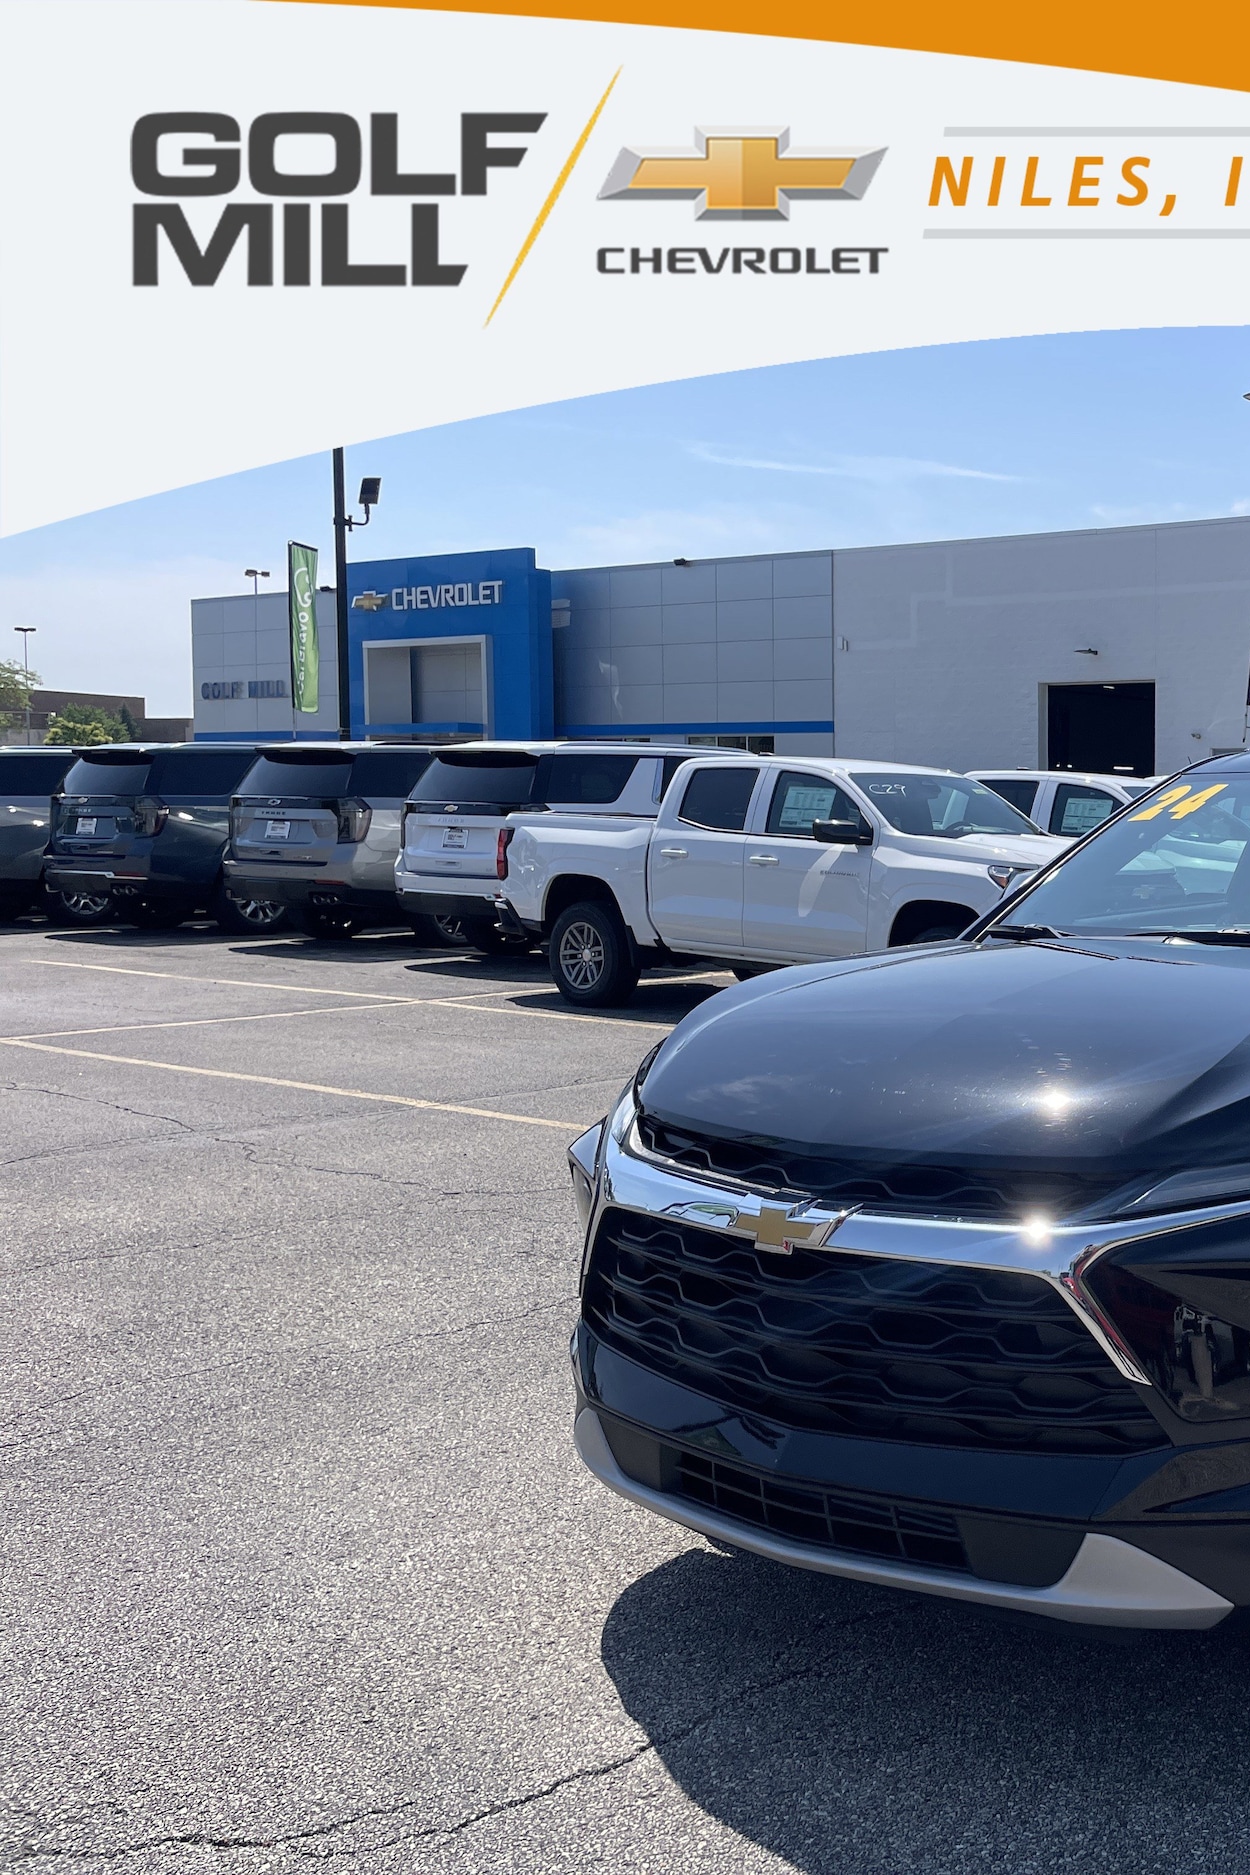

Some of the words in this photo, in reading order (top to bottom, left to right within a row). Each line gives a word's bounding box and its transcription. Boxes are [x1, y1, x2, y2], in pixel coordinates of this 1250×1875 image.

[391, 580, 503, 611] CHEVROLET
[201, 681, 242, 700] GOLF
[247, 680, 288, 699] MILL
[1128, 783, 1229, 822] 24
